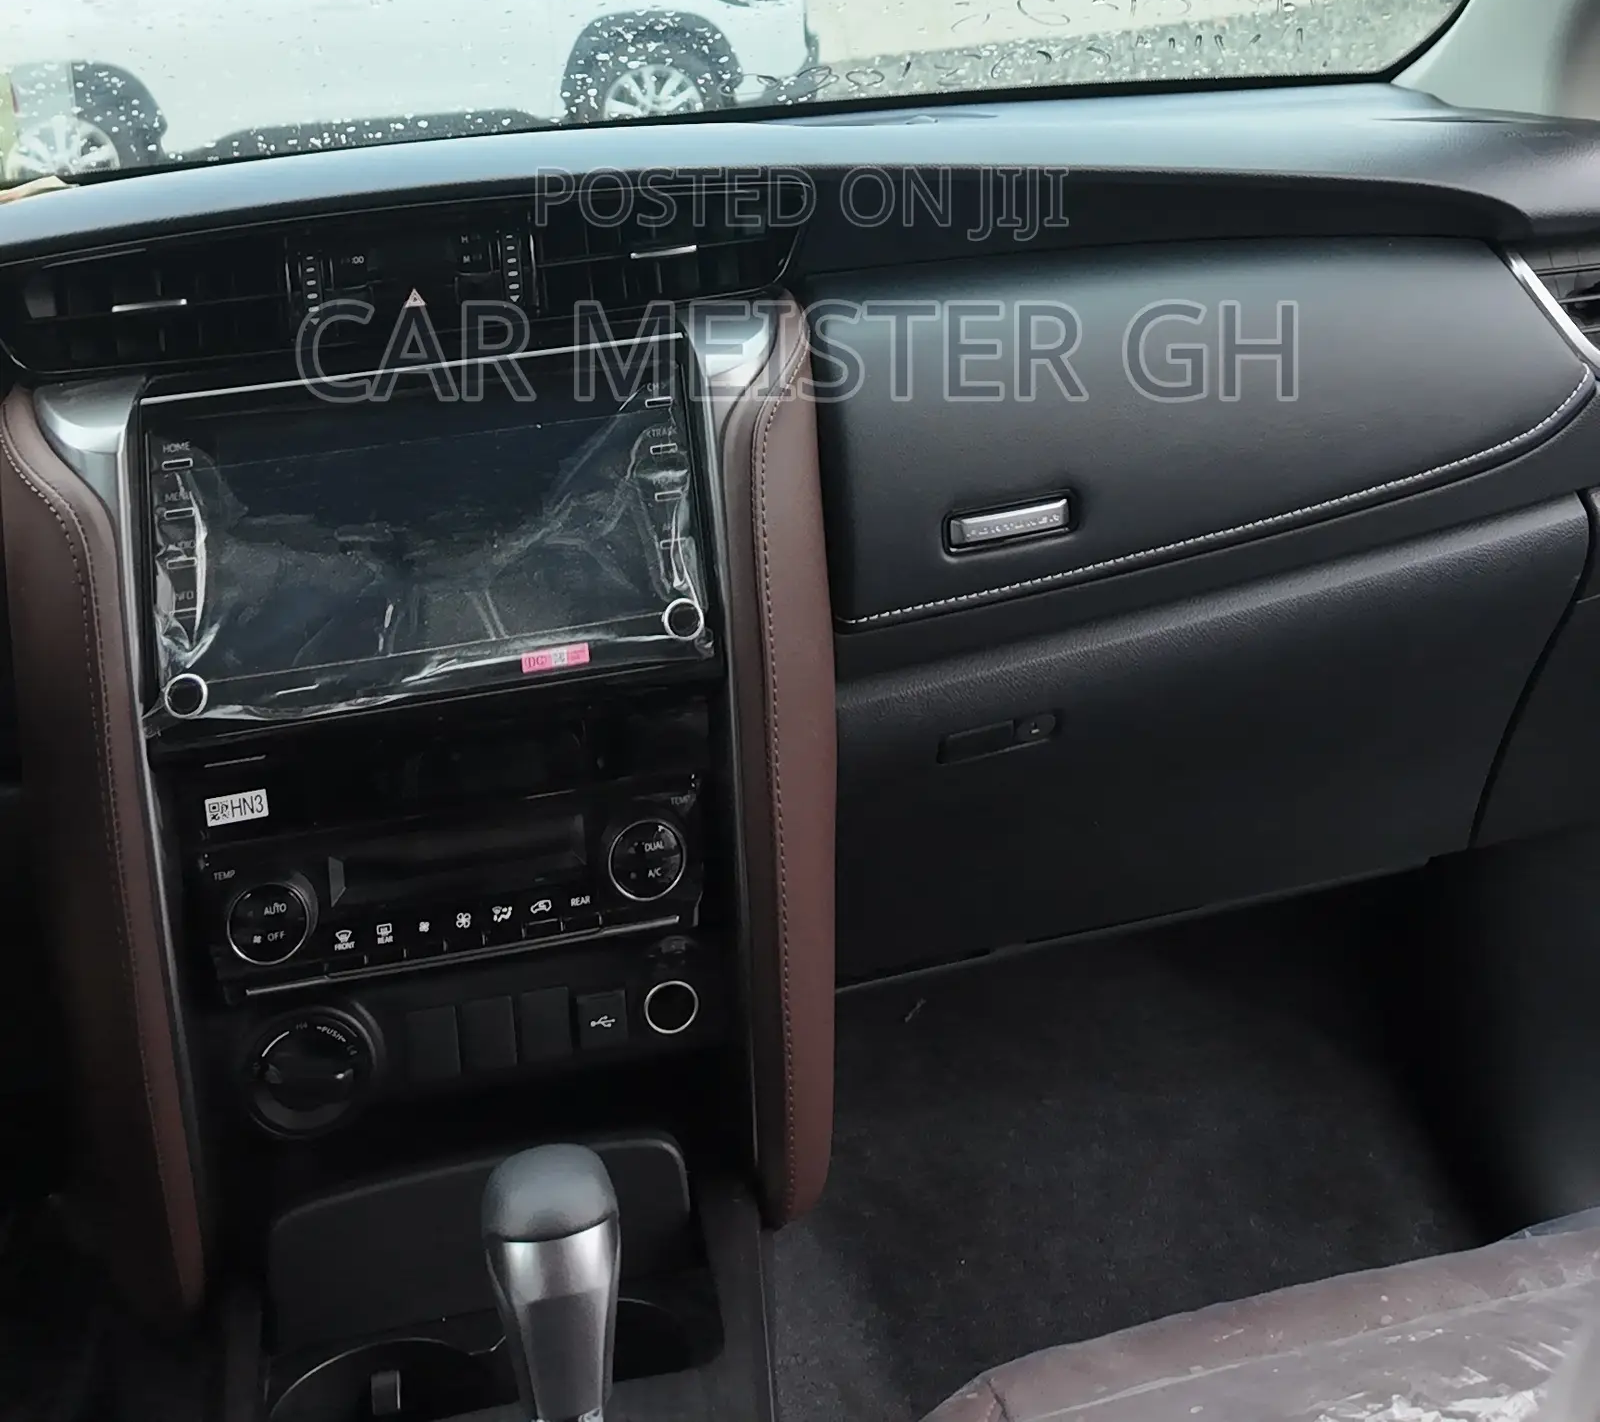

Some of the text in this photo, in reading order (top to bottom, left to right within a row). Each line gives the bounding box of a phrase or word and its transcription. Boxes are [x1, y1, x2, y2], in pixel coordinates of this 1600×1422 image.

[163, 441, 190, 453] HOME
[231, 794, 264, 818] HN3
[644, 841, 665, 852] DUAL
[213, 869, 236, 881] TEMP
[648, 867, 662, 878] A/C
[570, 895, 591, 907] REAR
[264, 903, 287, 916] AUTO
[267, 931, 286, 942] OFF
[377, 935, 394, 945] REAR
[334, 941, 356, 951] FRONT
